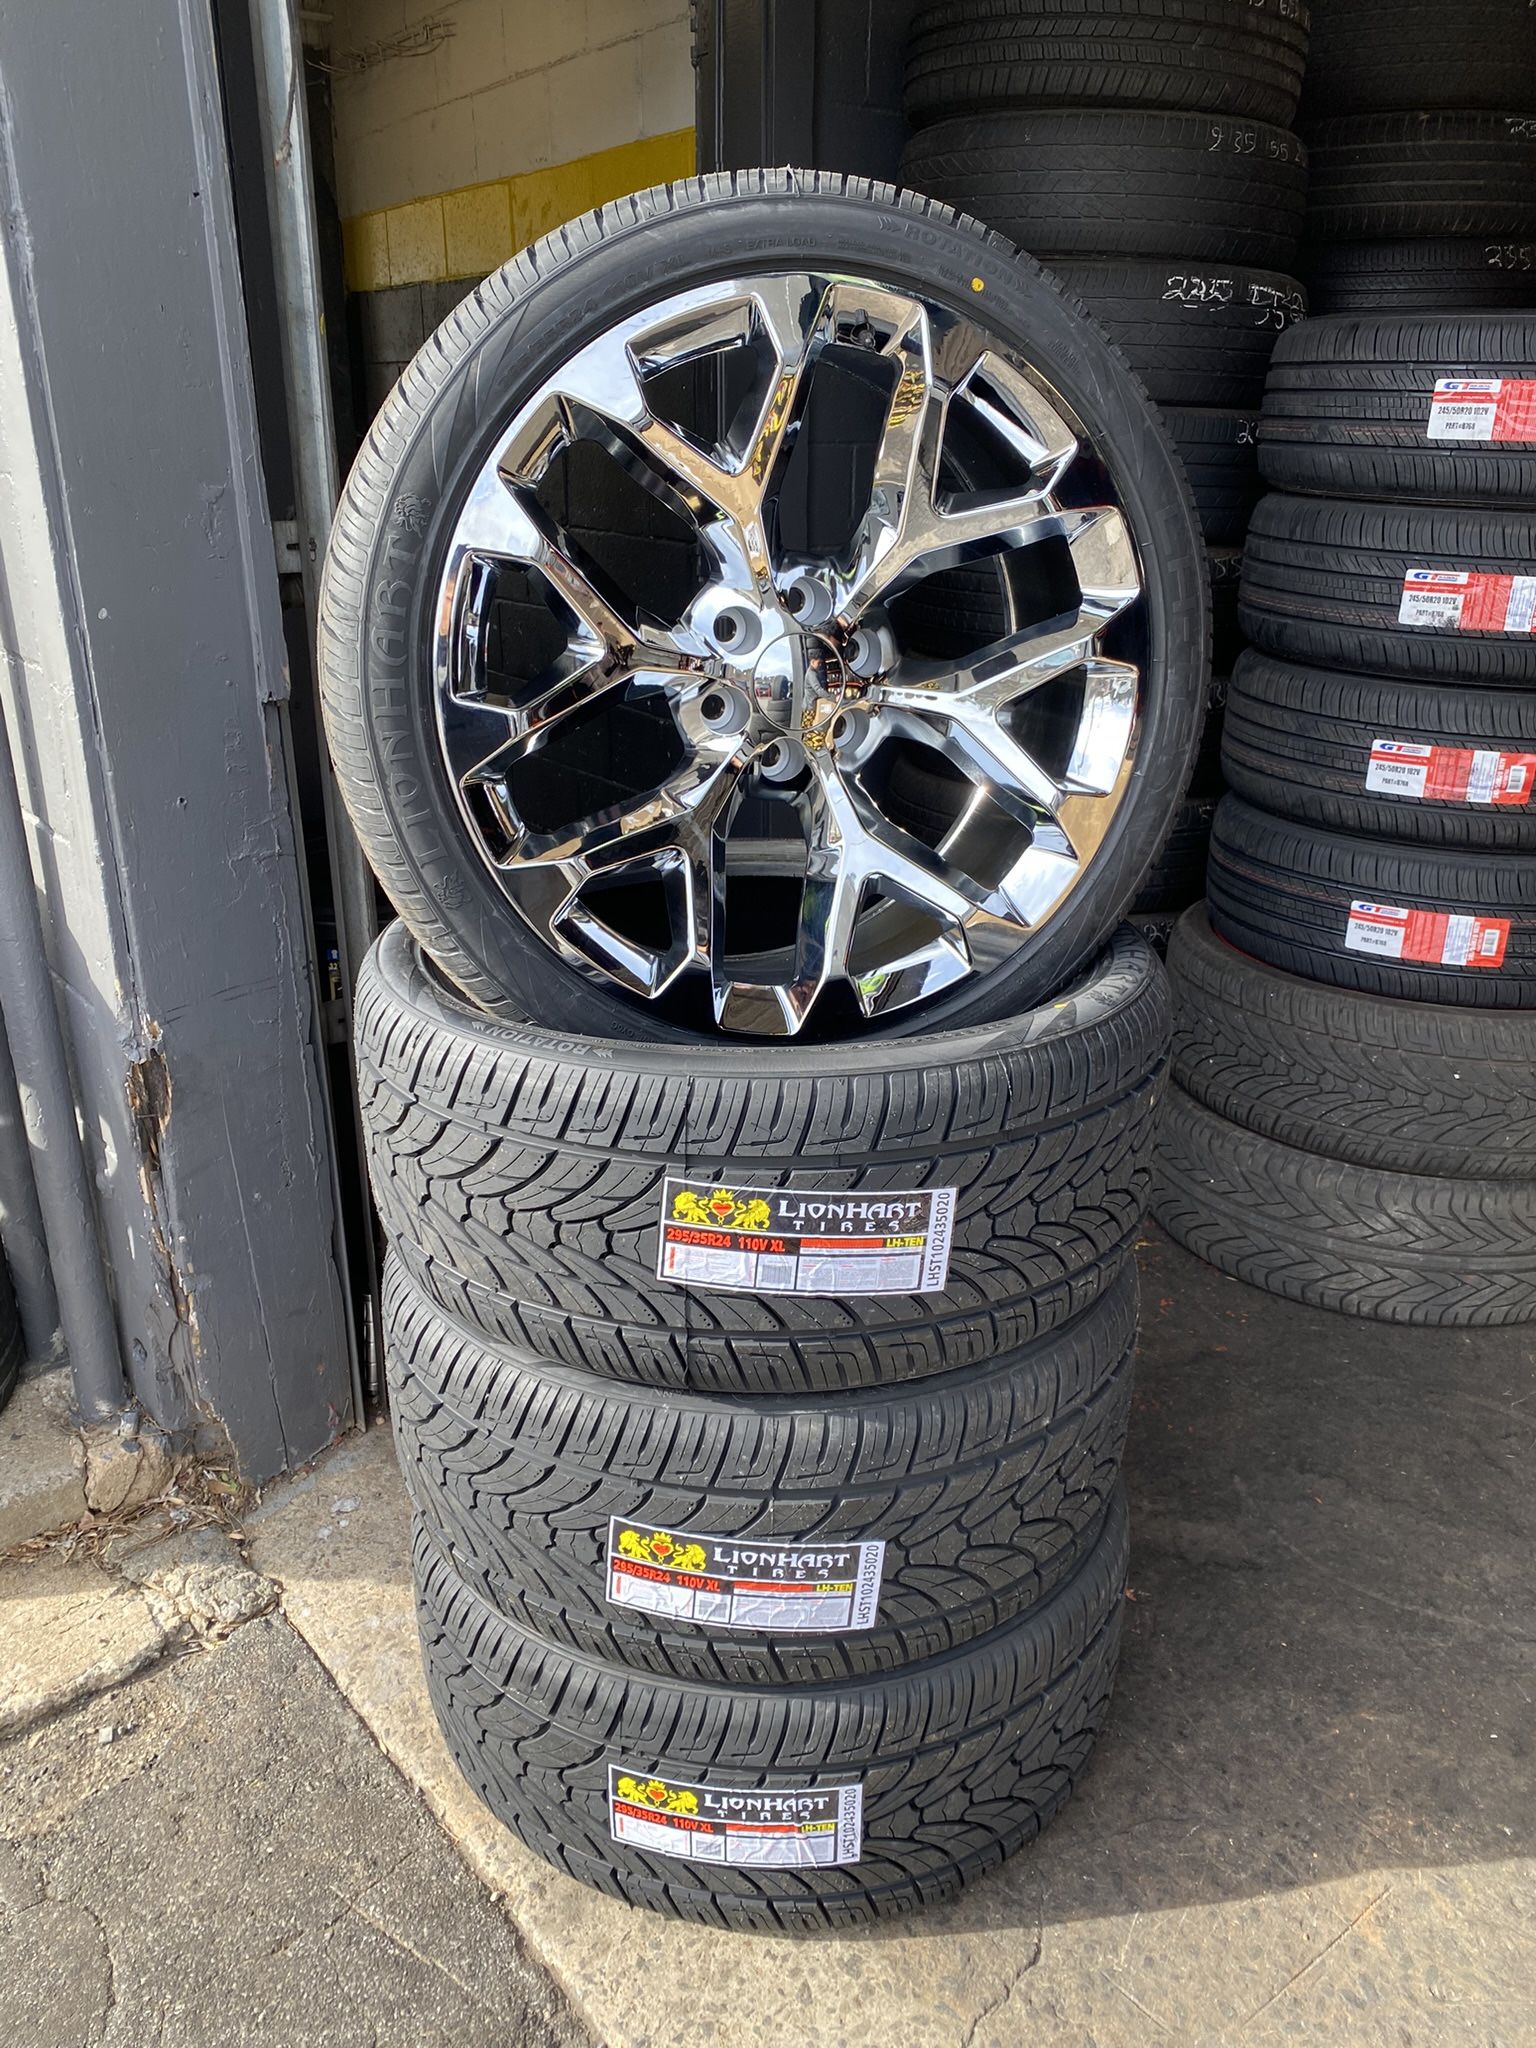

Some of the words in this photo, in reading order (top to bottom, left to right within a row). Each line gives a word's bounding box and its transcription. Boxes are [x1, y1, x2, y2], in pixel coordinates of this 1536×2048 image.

[369, 534, 448, 869] LIONHART
[486, 1026, 592, 1056] ROTATION
[778, 1200, 922, 1221] LIONHART
[793, 1220, 900, 1233] TIRES
[666, 1228, 732, 1248] 295/35R24
[738, 1236, 768, 1251] 110V
[769, 1240, 786, 1253] XL
[886, 1237, 924, 1249] LH-TEN
[926, 1192, 951, 1288] LHST102435020
[713, 1547, 850, 1569] LIONHART
[613, 1559, 671, 1583] 295/35R24
[676, 1574, 705, 1590] 110V
[705, 1579, 721, 1592] XL
[727, 1566, 830, 1579] TIRES
[815, 1583, 854, 1593] LH-TEN
[856, 1545, 880, 1626] LHST102435020
[704, 1793, 829, 1812] LIONHART
[615, 1802, 668, 1825] 295/35R24
[672, 1818, 699, 1832] 110V
[699, 1823, 714, 1833] XL
[717, 1809, 811, 1821] TIRES
[842, 1788, 857, 1859] LHST102435020
[801, 1822, 836, 1833] LH-TEN
